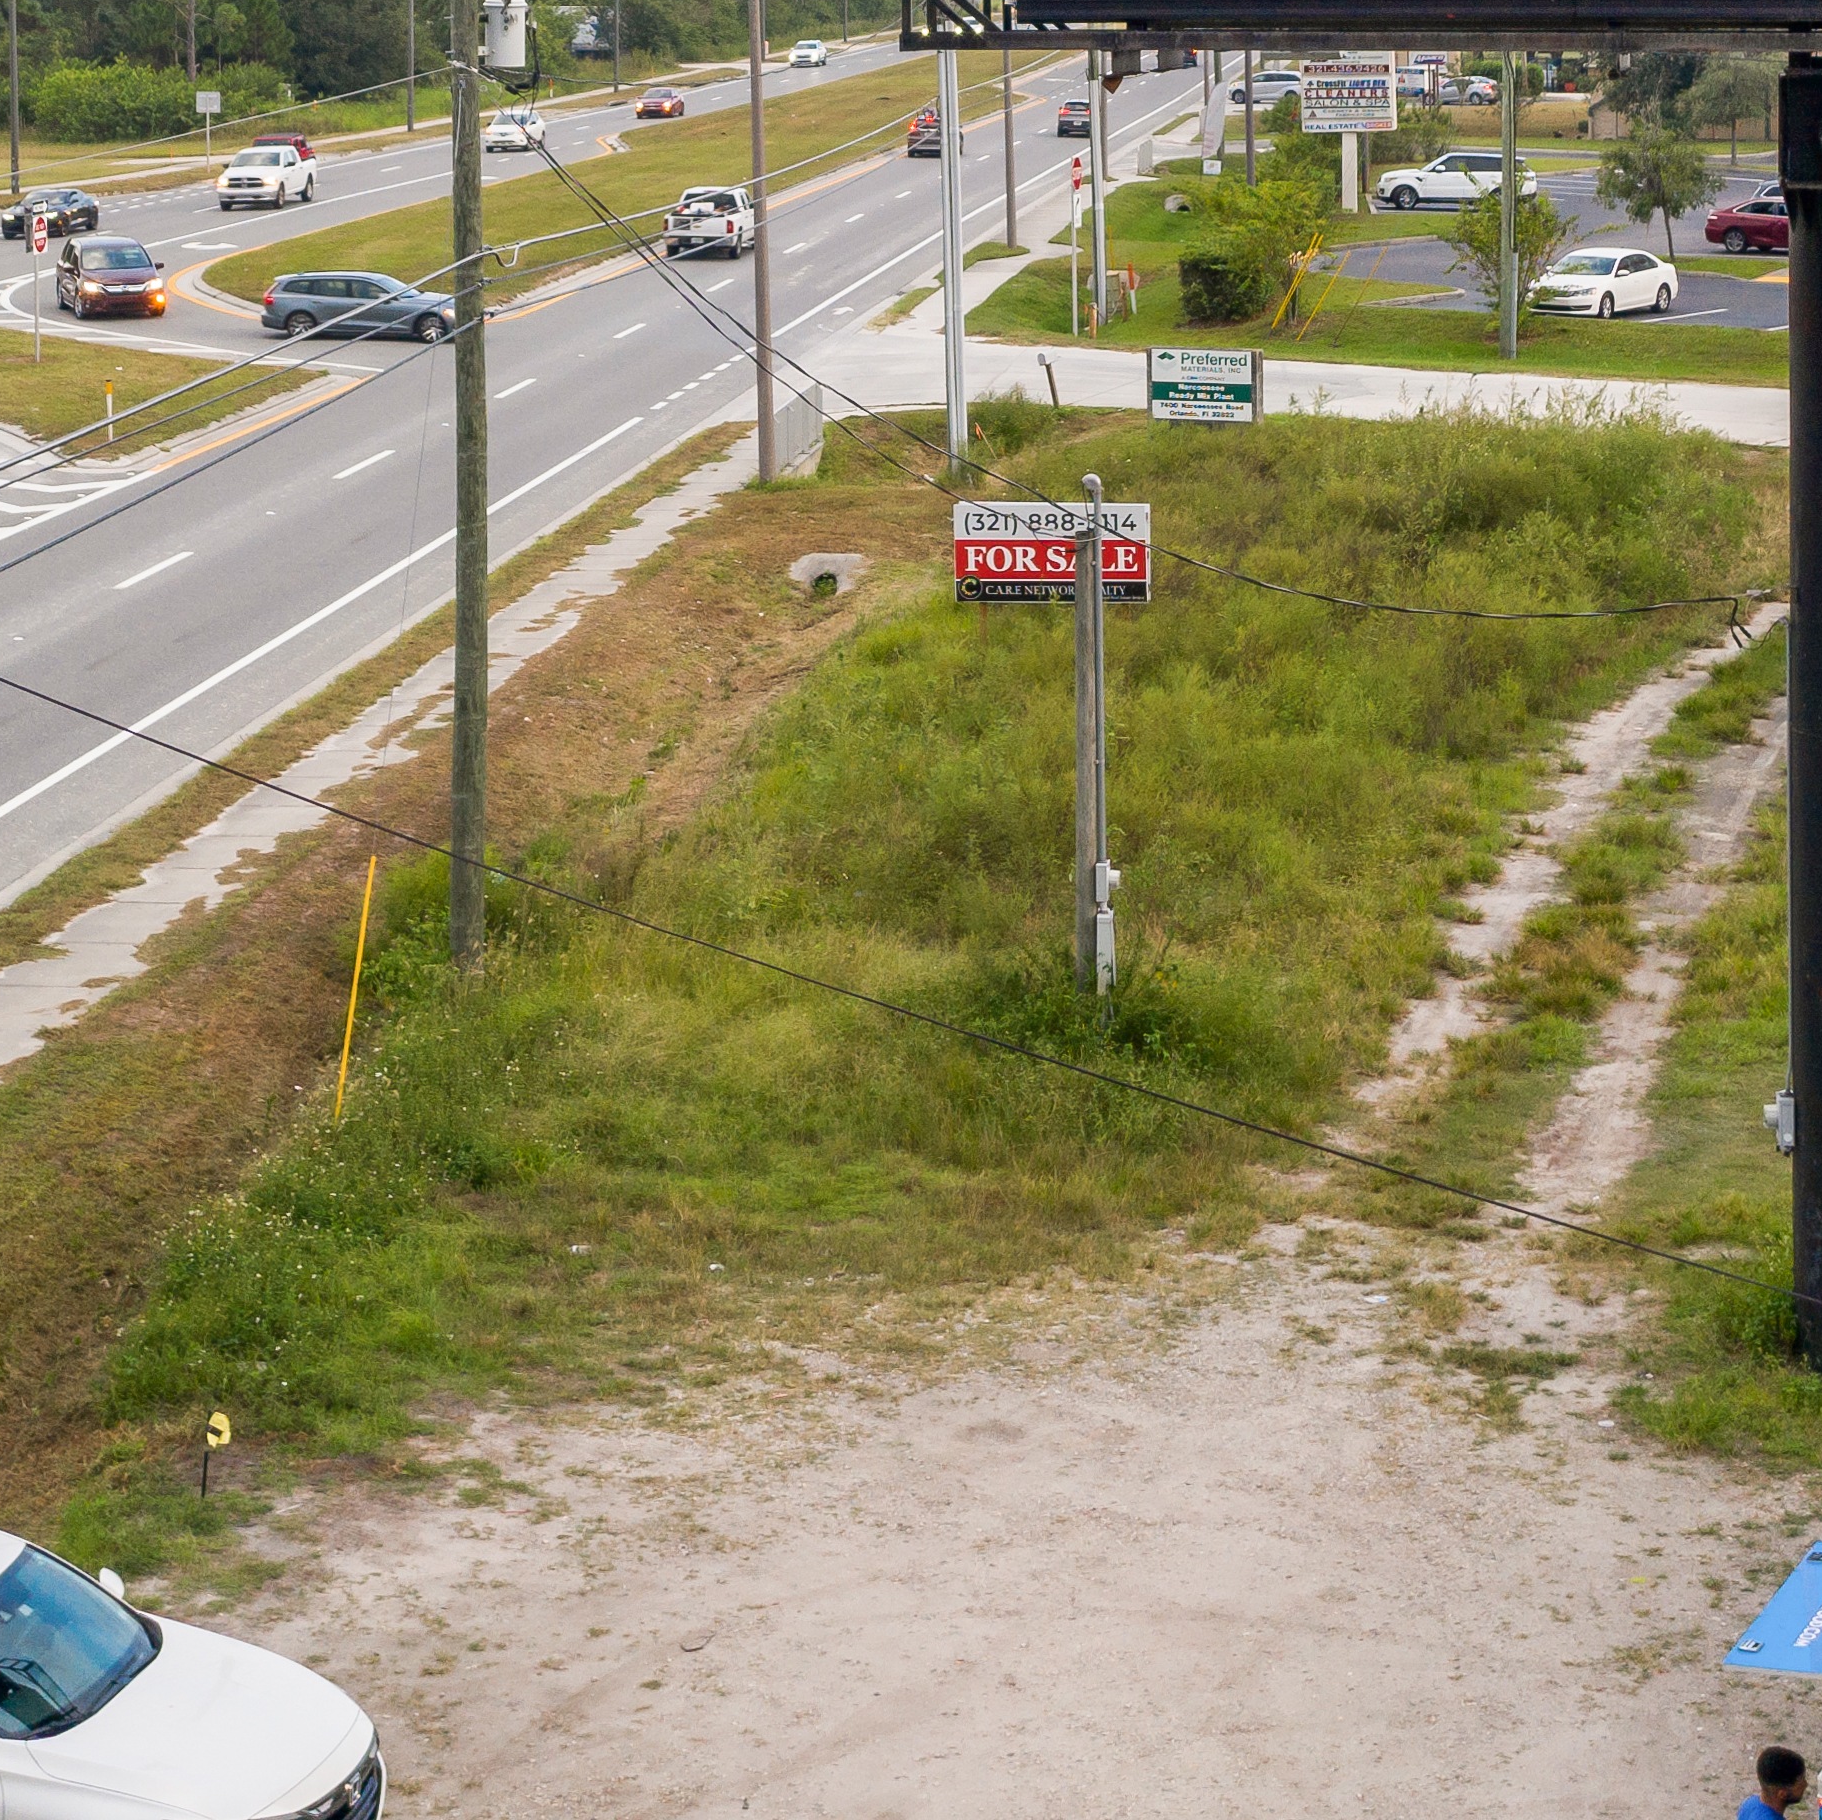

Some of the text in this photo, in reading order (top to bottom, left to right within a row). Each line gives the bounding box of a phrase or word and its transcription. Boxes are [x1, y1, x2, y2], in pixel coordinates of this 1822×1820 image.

[1305, 89, 1388, 98] CLEANERS
[1305, 98, 1390, 107] SALON & SPA
[1181, 352, 1248, 367] Preferred
[964, 512, 1018, 536] (321)
[965, 546, 1040, 572] FOR
[985, 585, 1022, 595] CARE
[1024, 585, 1076, 595] NETWOR
